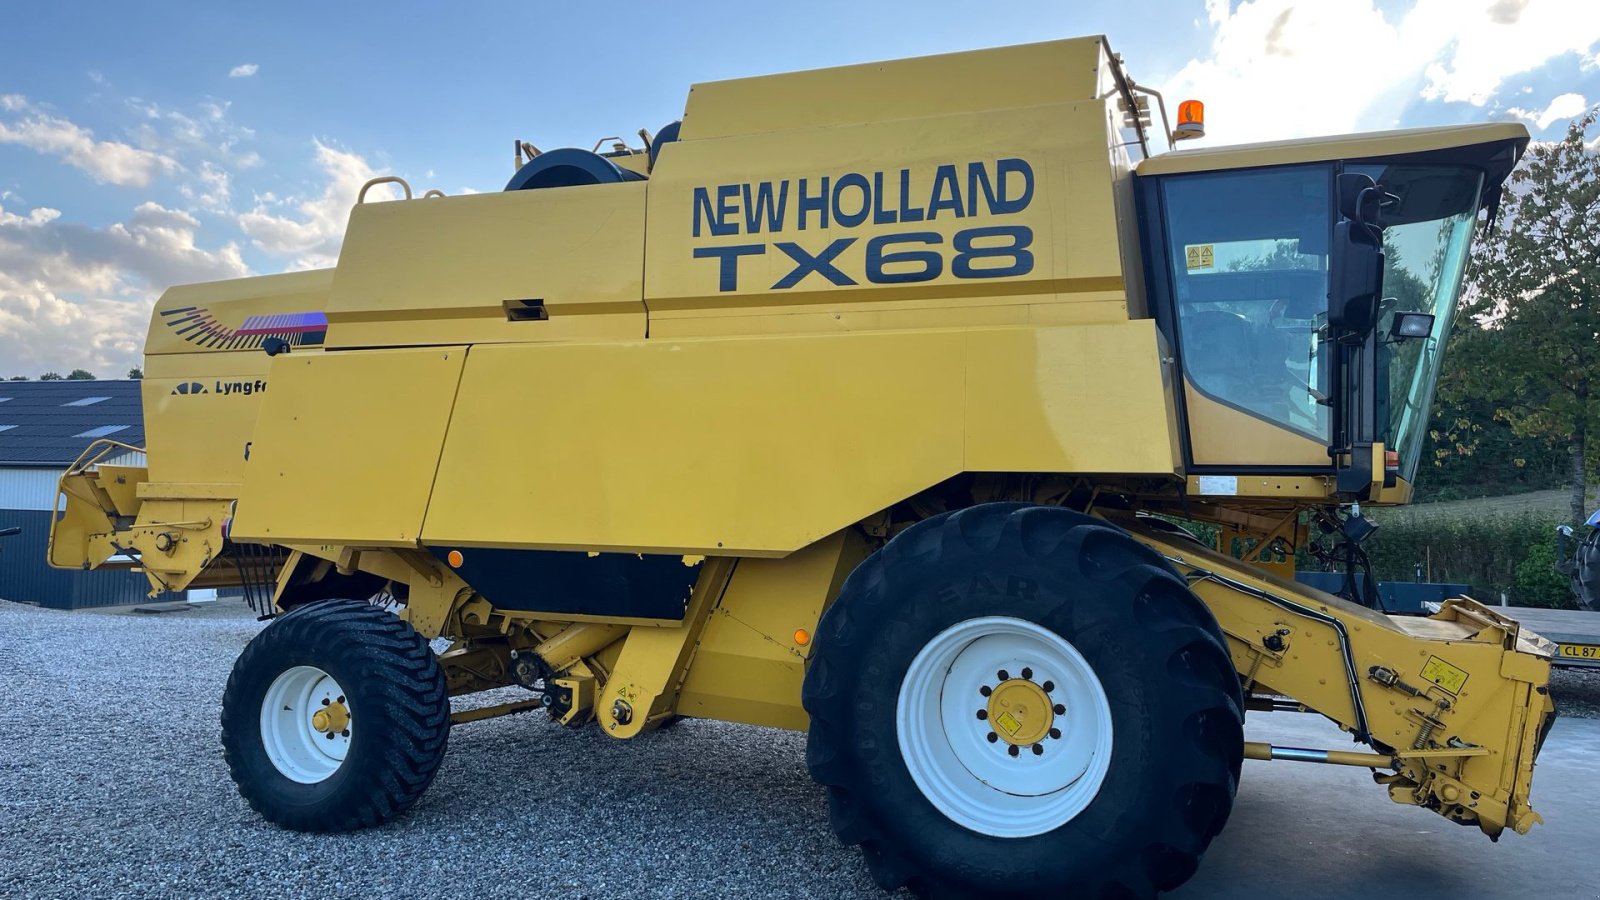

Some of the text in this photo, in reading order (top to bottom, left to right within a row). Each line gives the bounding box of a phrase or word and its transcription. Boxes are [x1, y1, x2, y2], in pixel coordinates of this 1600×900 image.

[692, 158, 1035, 237] NEW HOLLAND
[693, 225, 1034, 292] TX68
[1565, 646, 1597, 657] CL 87
